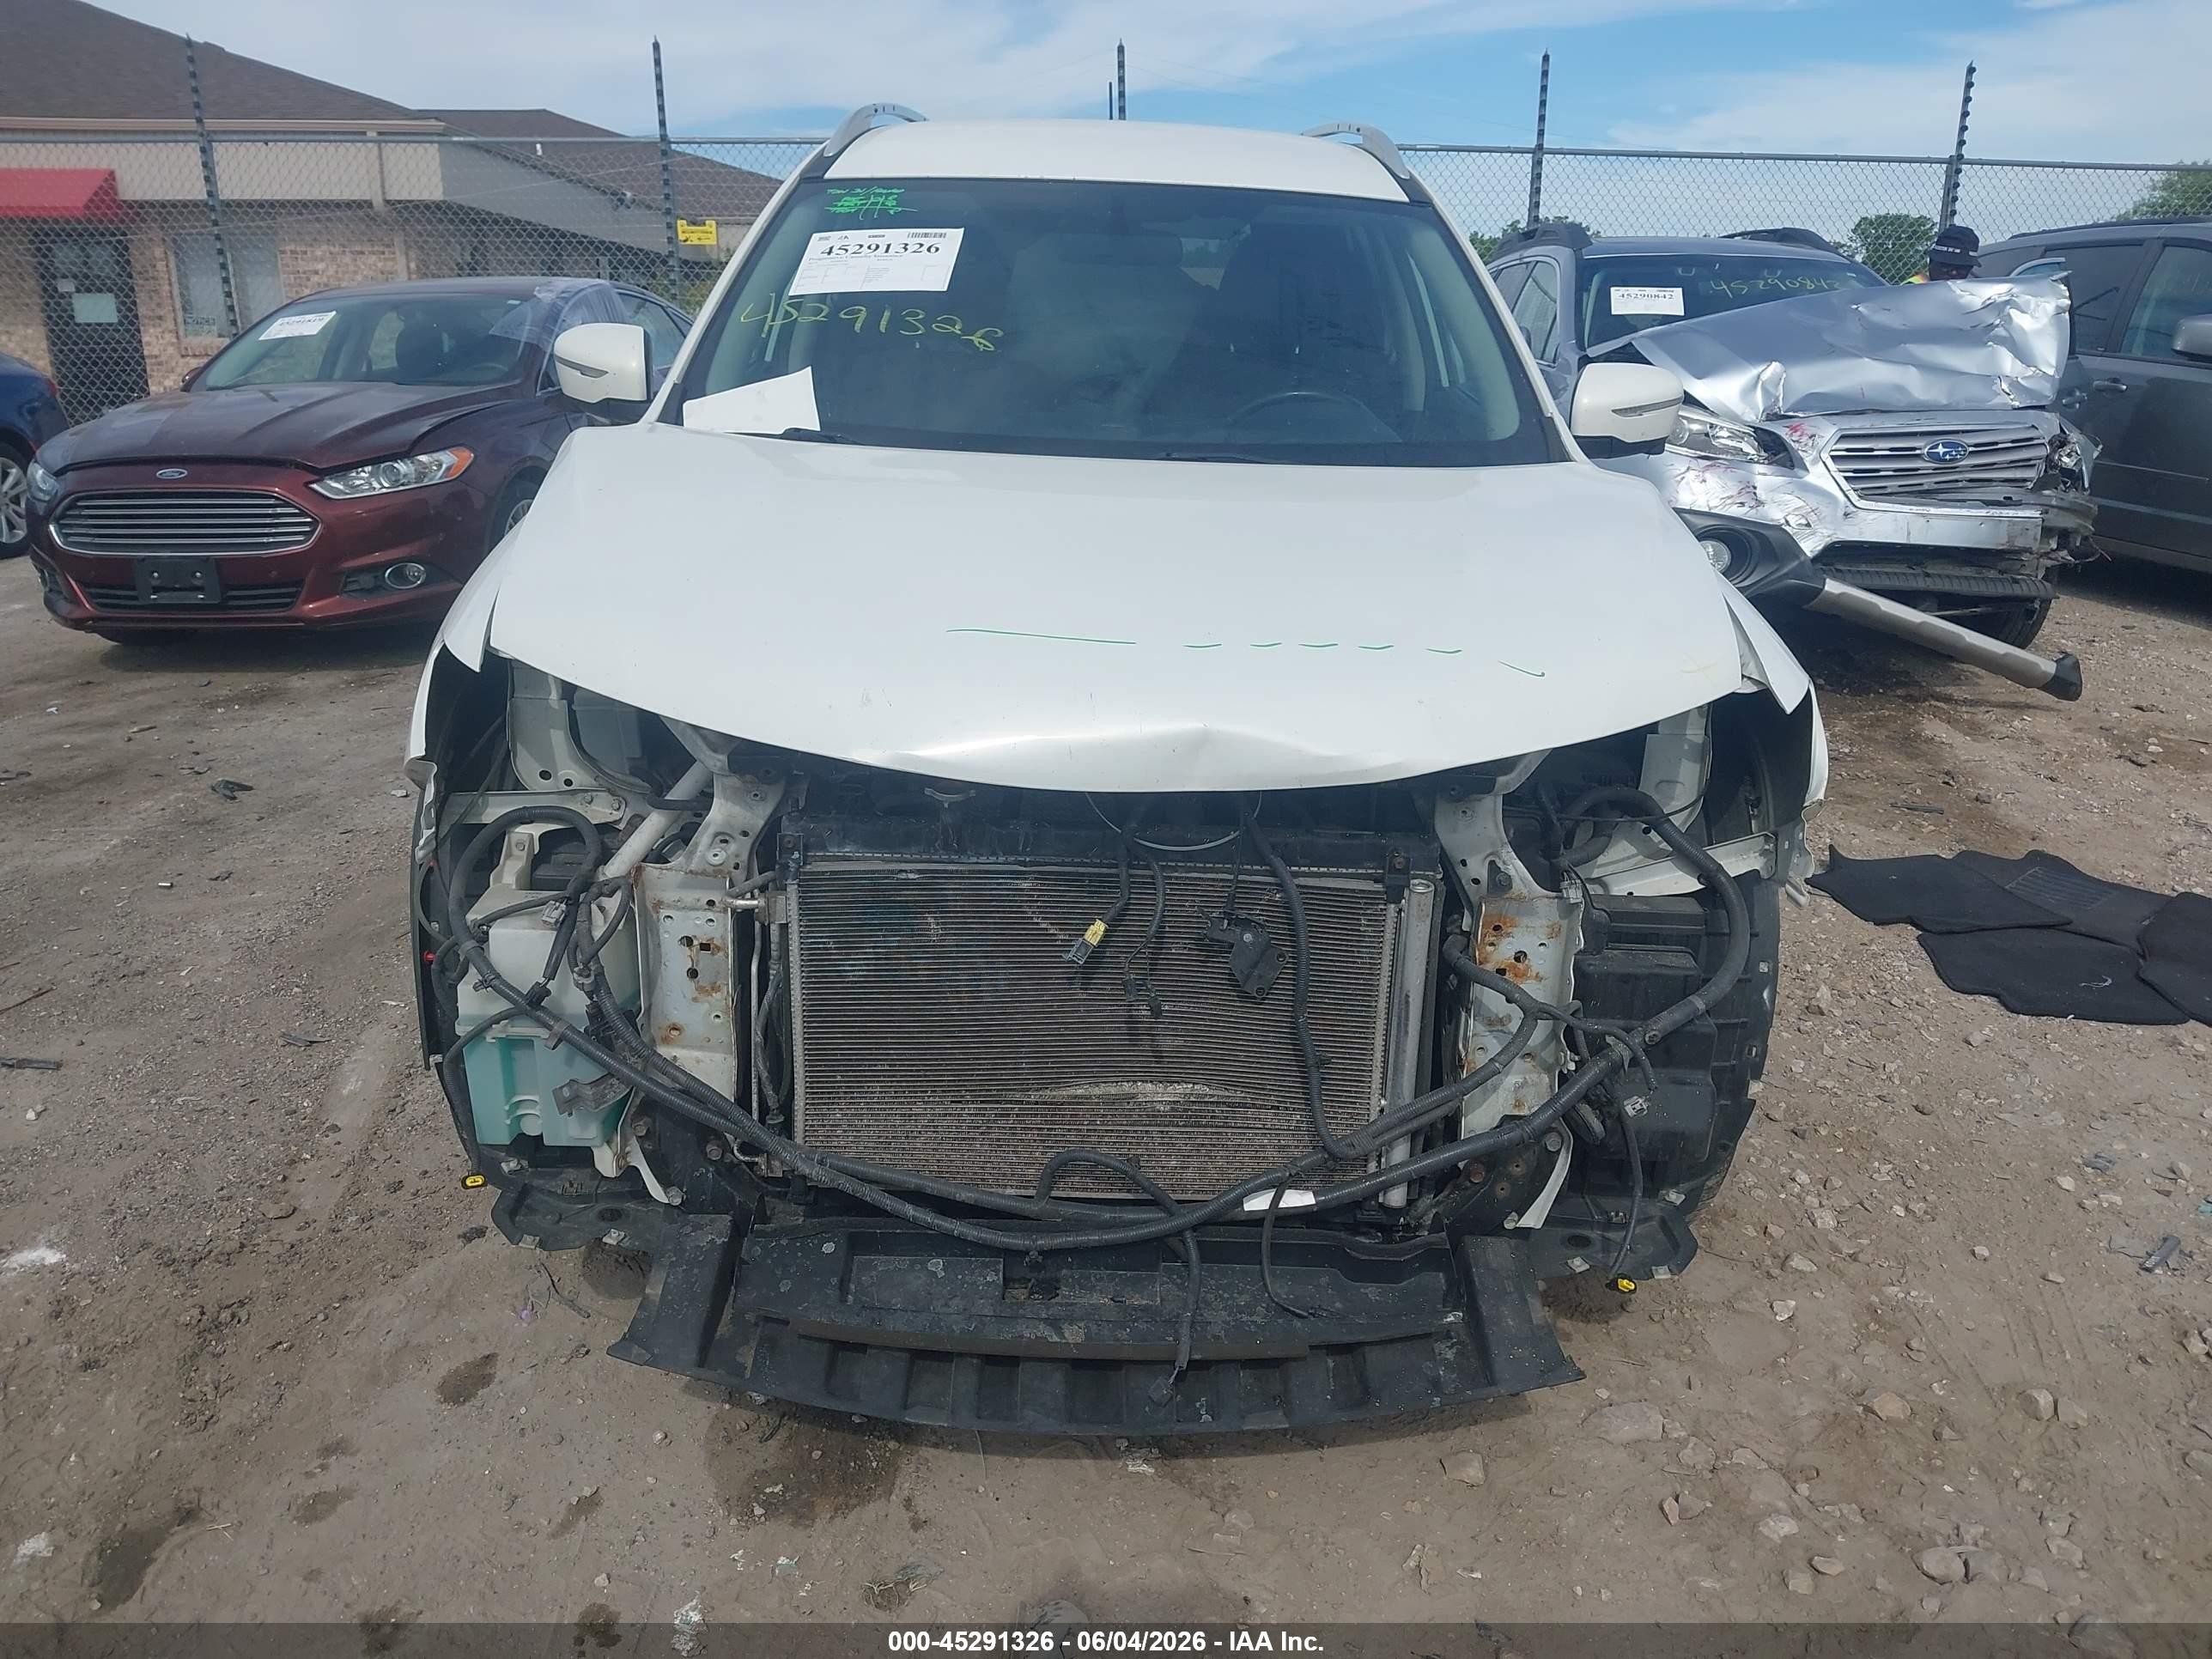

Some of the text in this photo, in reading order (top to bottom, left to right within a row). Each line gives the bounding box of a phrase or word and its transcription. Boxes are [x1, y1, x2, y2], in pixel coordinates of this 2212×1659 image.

[820, 242, 941, 257] 45291326
[1710, 276, 1842, 299] 45290842
[740, 292, 1004, 351] 45291326
